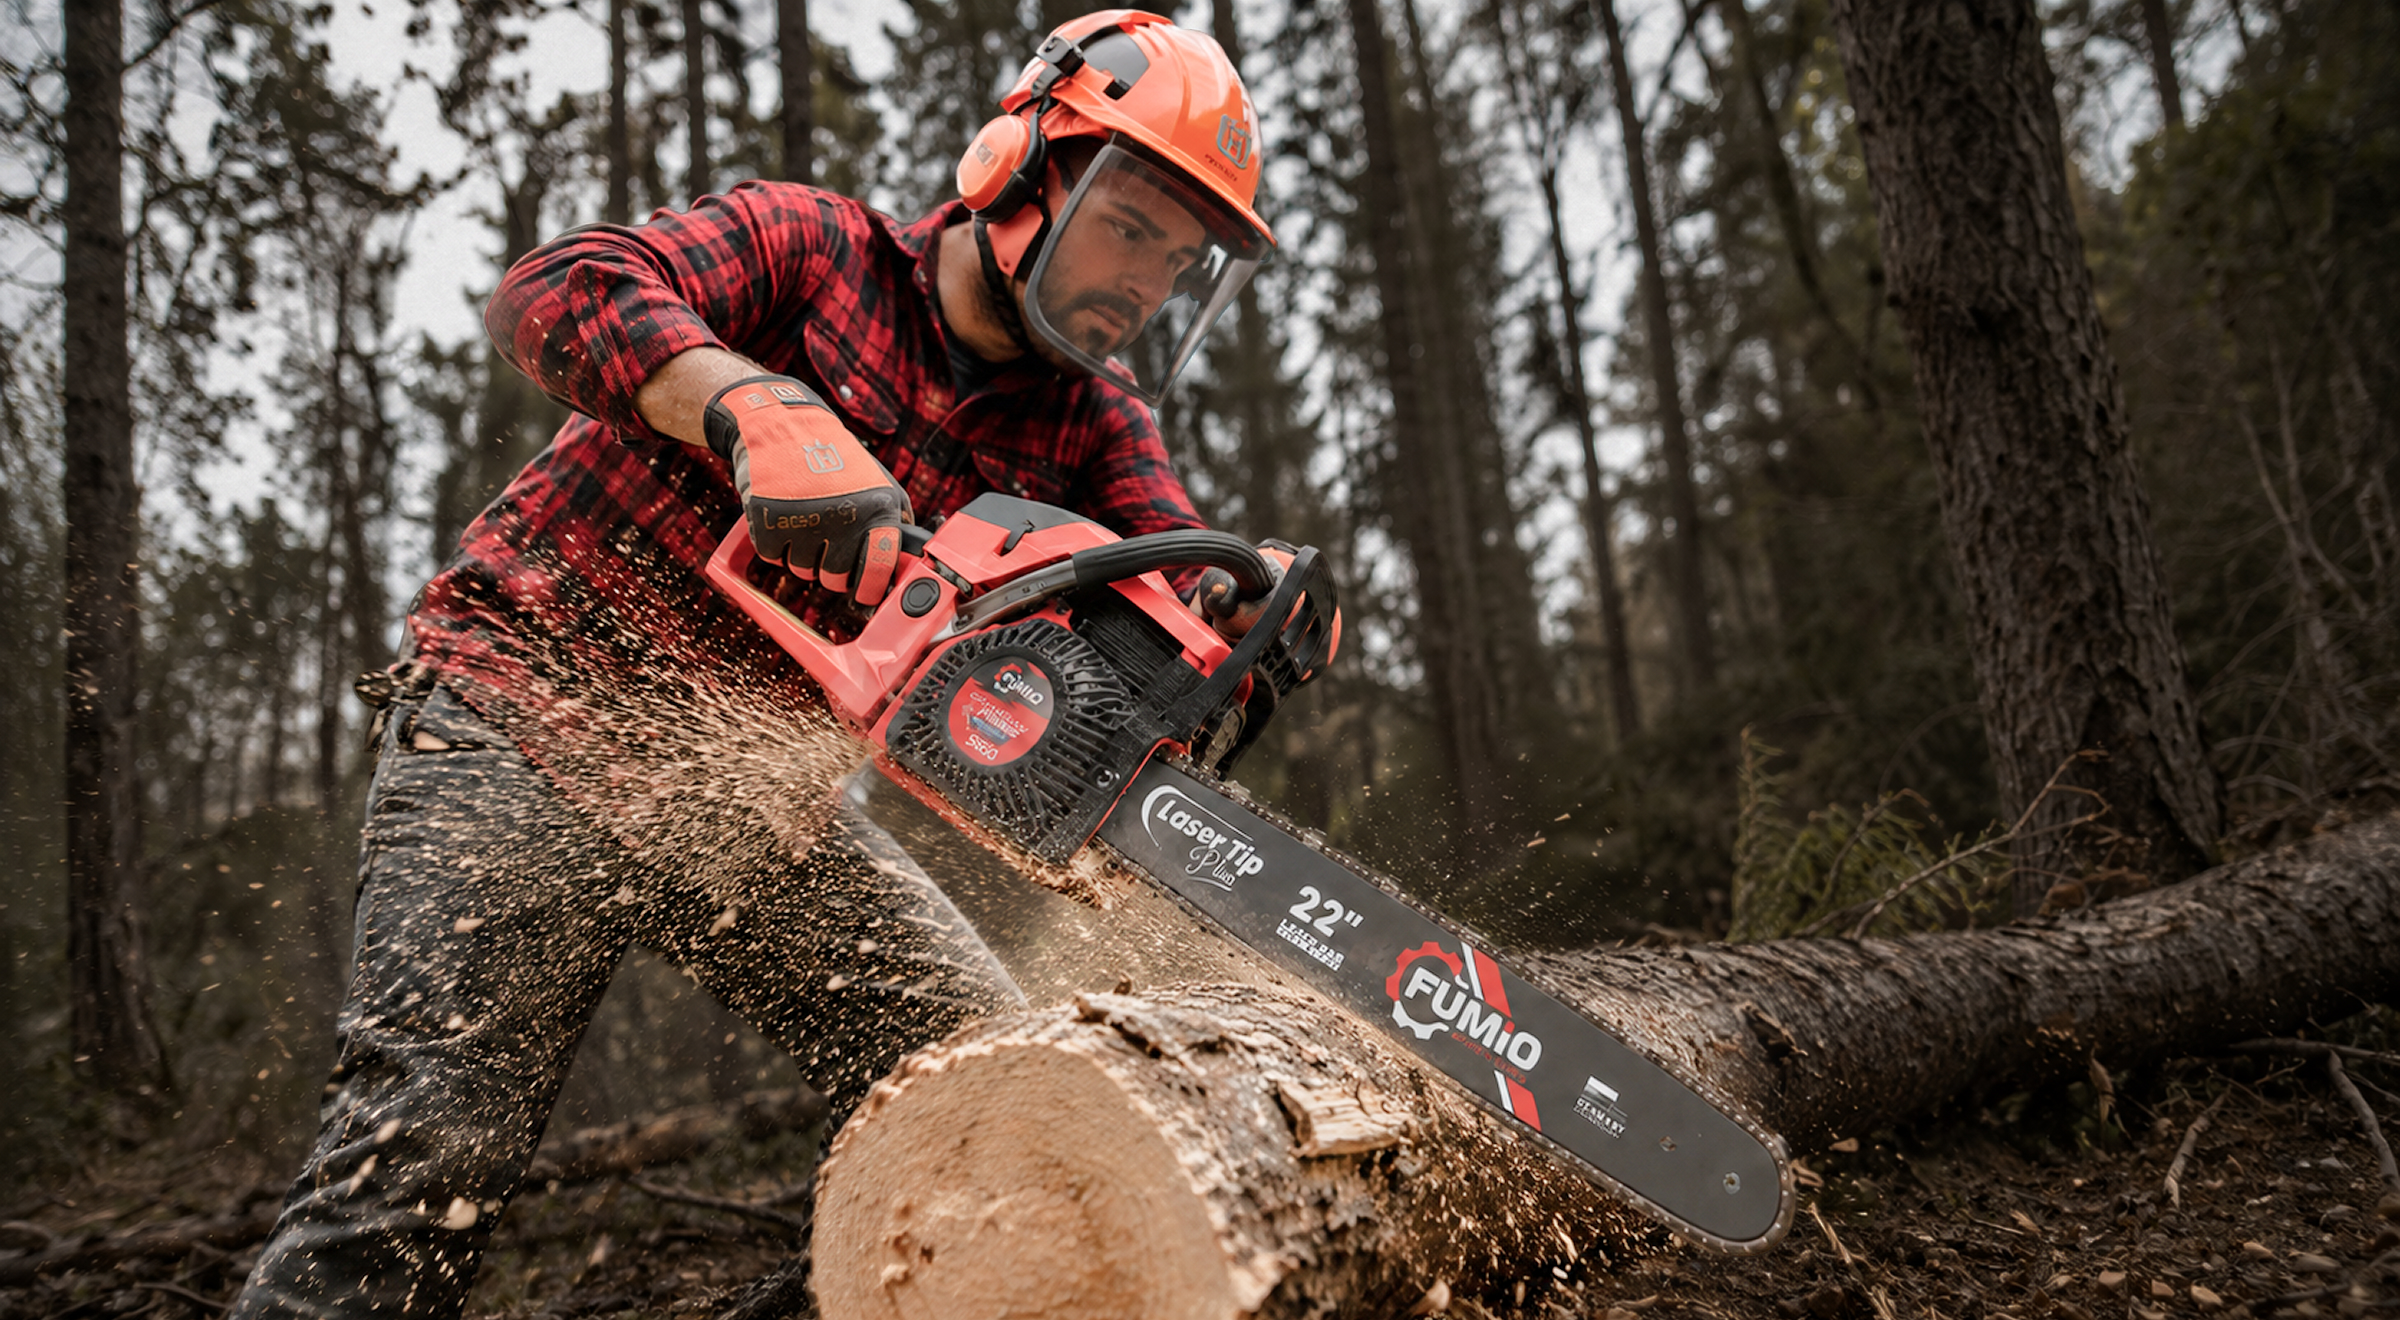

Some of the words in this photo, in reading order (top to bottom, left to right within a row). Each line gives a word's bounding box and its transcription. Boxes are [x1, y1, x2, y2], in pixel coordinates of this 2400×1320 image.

[1157, 799, 1227, 849] Laser
[1226, 839, 1264, 877] Tip
[1289, 885, 1364, 938] 22"
